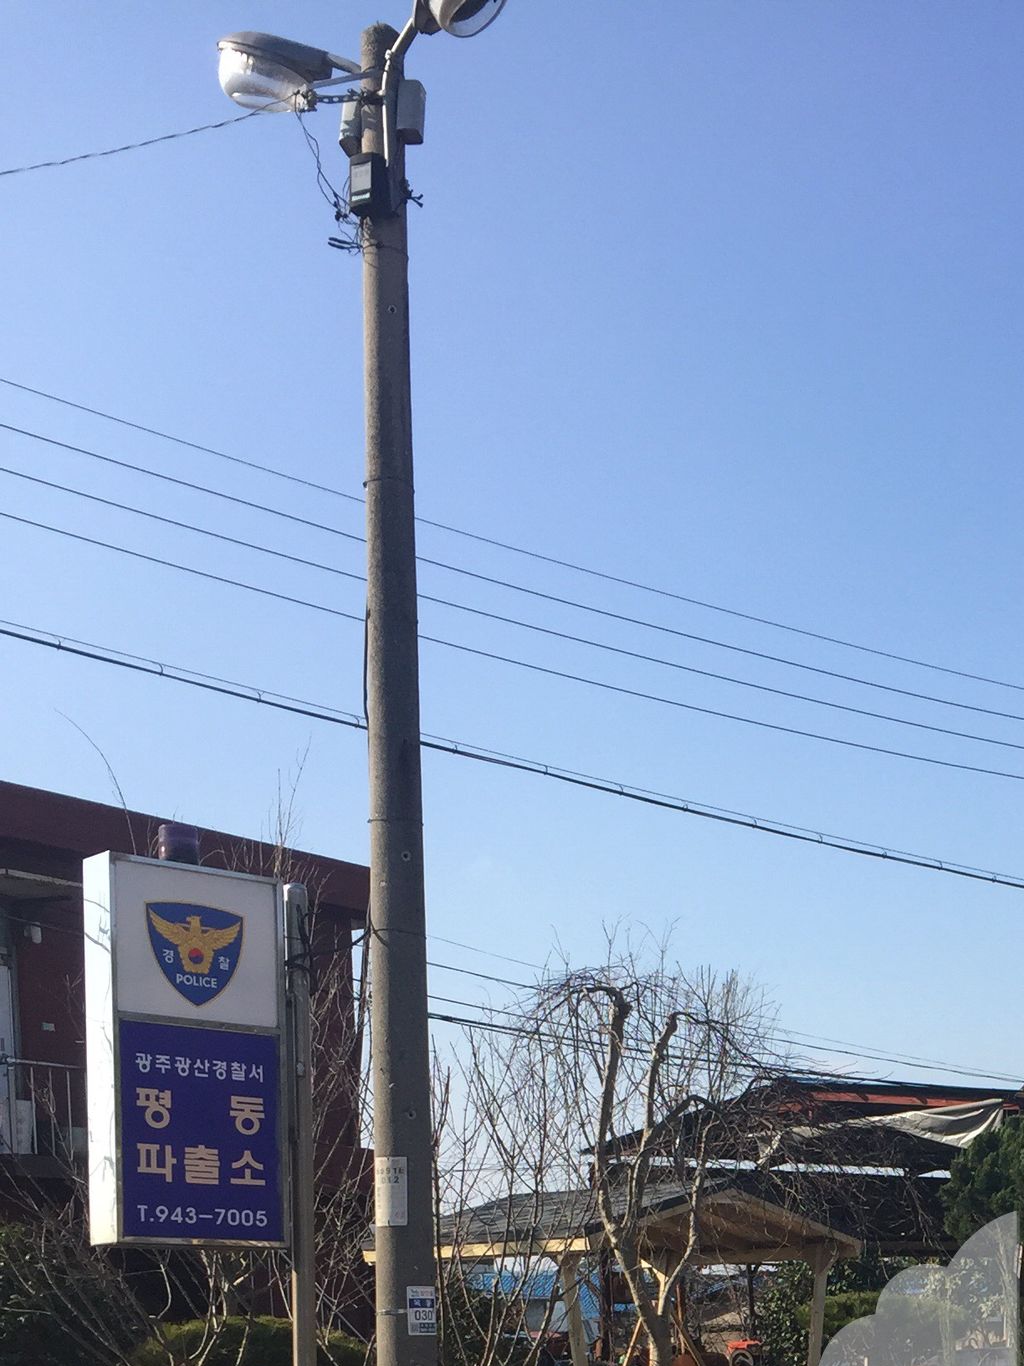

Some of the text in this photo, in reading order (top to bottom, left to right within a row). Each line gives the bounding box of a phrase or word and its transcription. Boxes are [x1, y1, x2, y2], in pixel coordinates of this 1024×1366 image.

[162, 949, 230, 971] 경 찰
[175, 973, 218, 989] POLICE
[135, 1052, 264, 1083] 광주광산경찰서
[136, 1142, 267, 1186] 파출소
[136, 1204, 269, 1228] T.943-7005
[414, 1309, 433, 1321] 030
